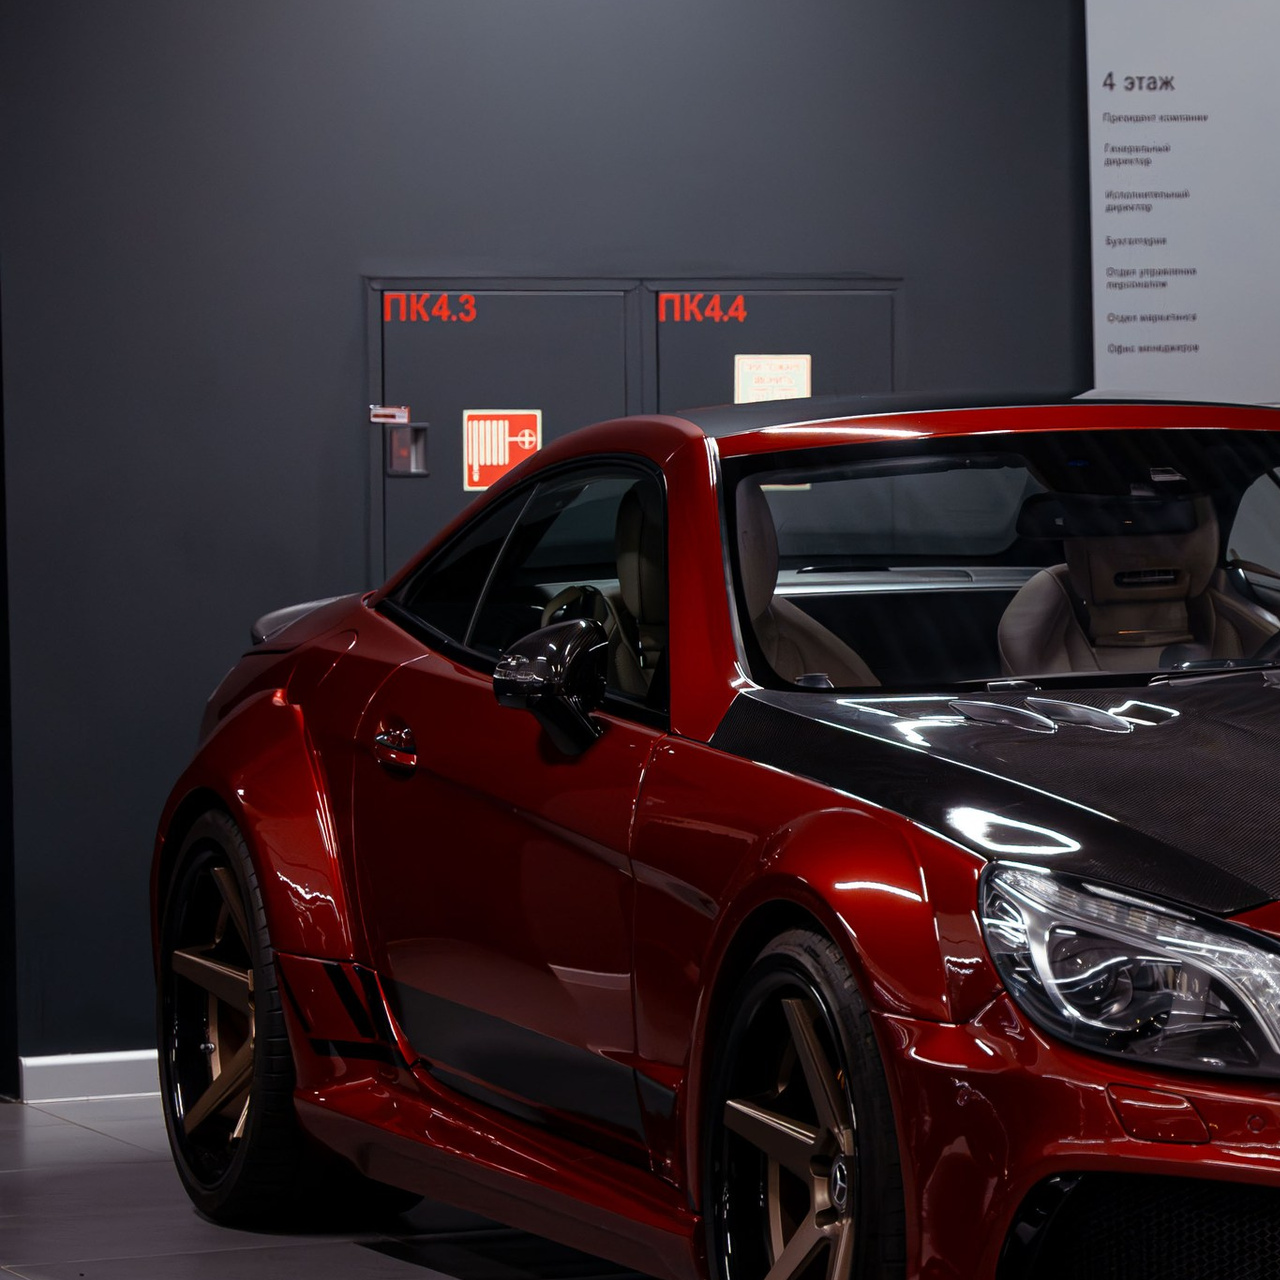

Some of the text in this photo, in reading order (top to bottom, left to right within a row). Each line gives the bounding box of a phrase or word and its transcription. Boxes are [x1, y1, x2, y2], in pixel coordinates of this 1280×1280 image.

[1102, 71, 1176, 91] 4 этаж
[383, 293, 477, 322] ПК4.3
[658, 293, 747, 322] ПК4.4
